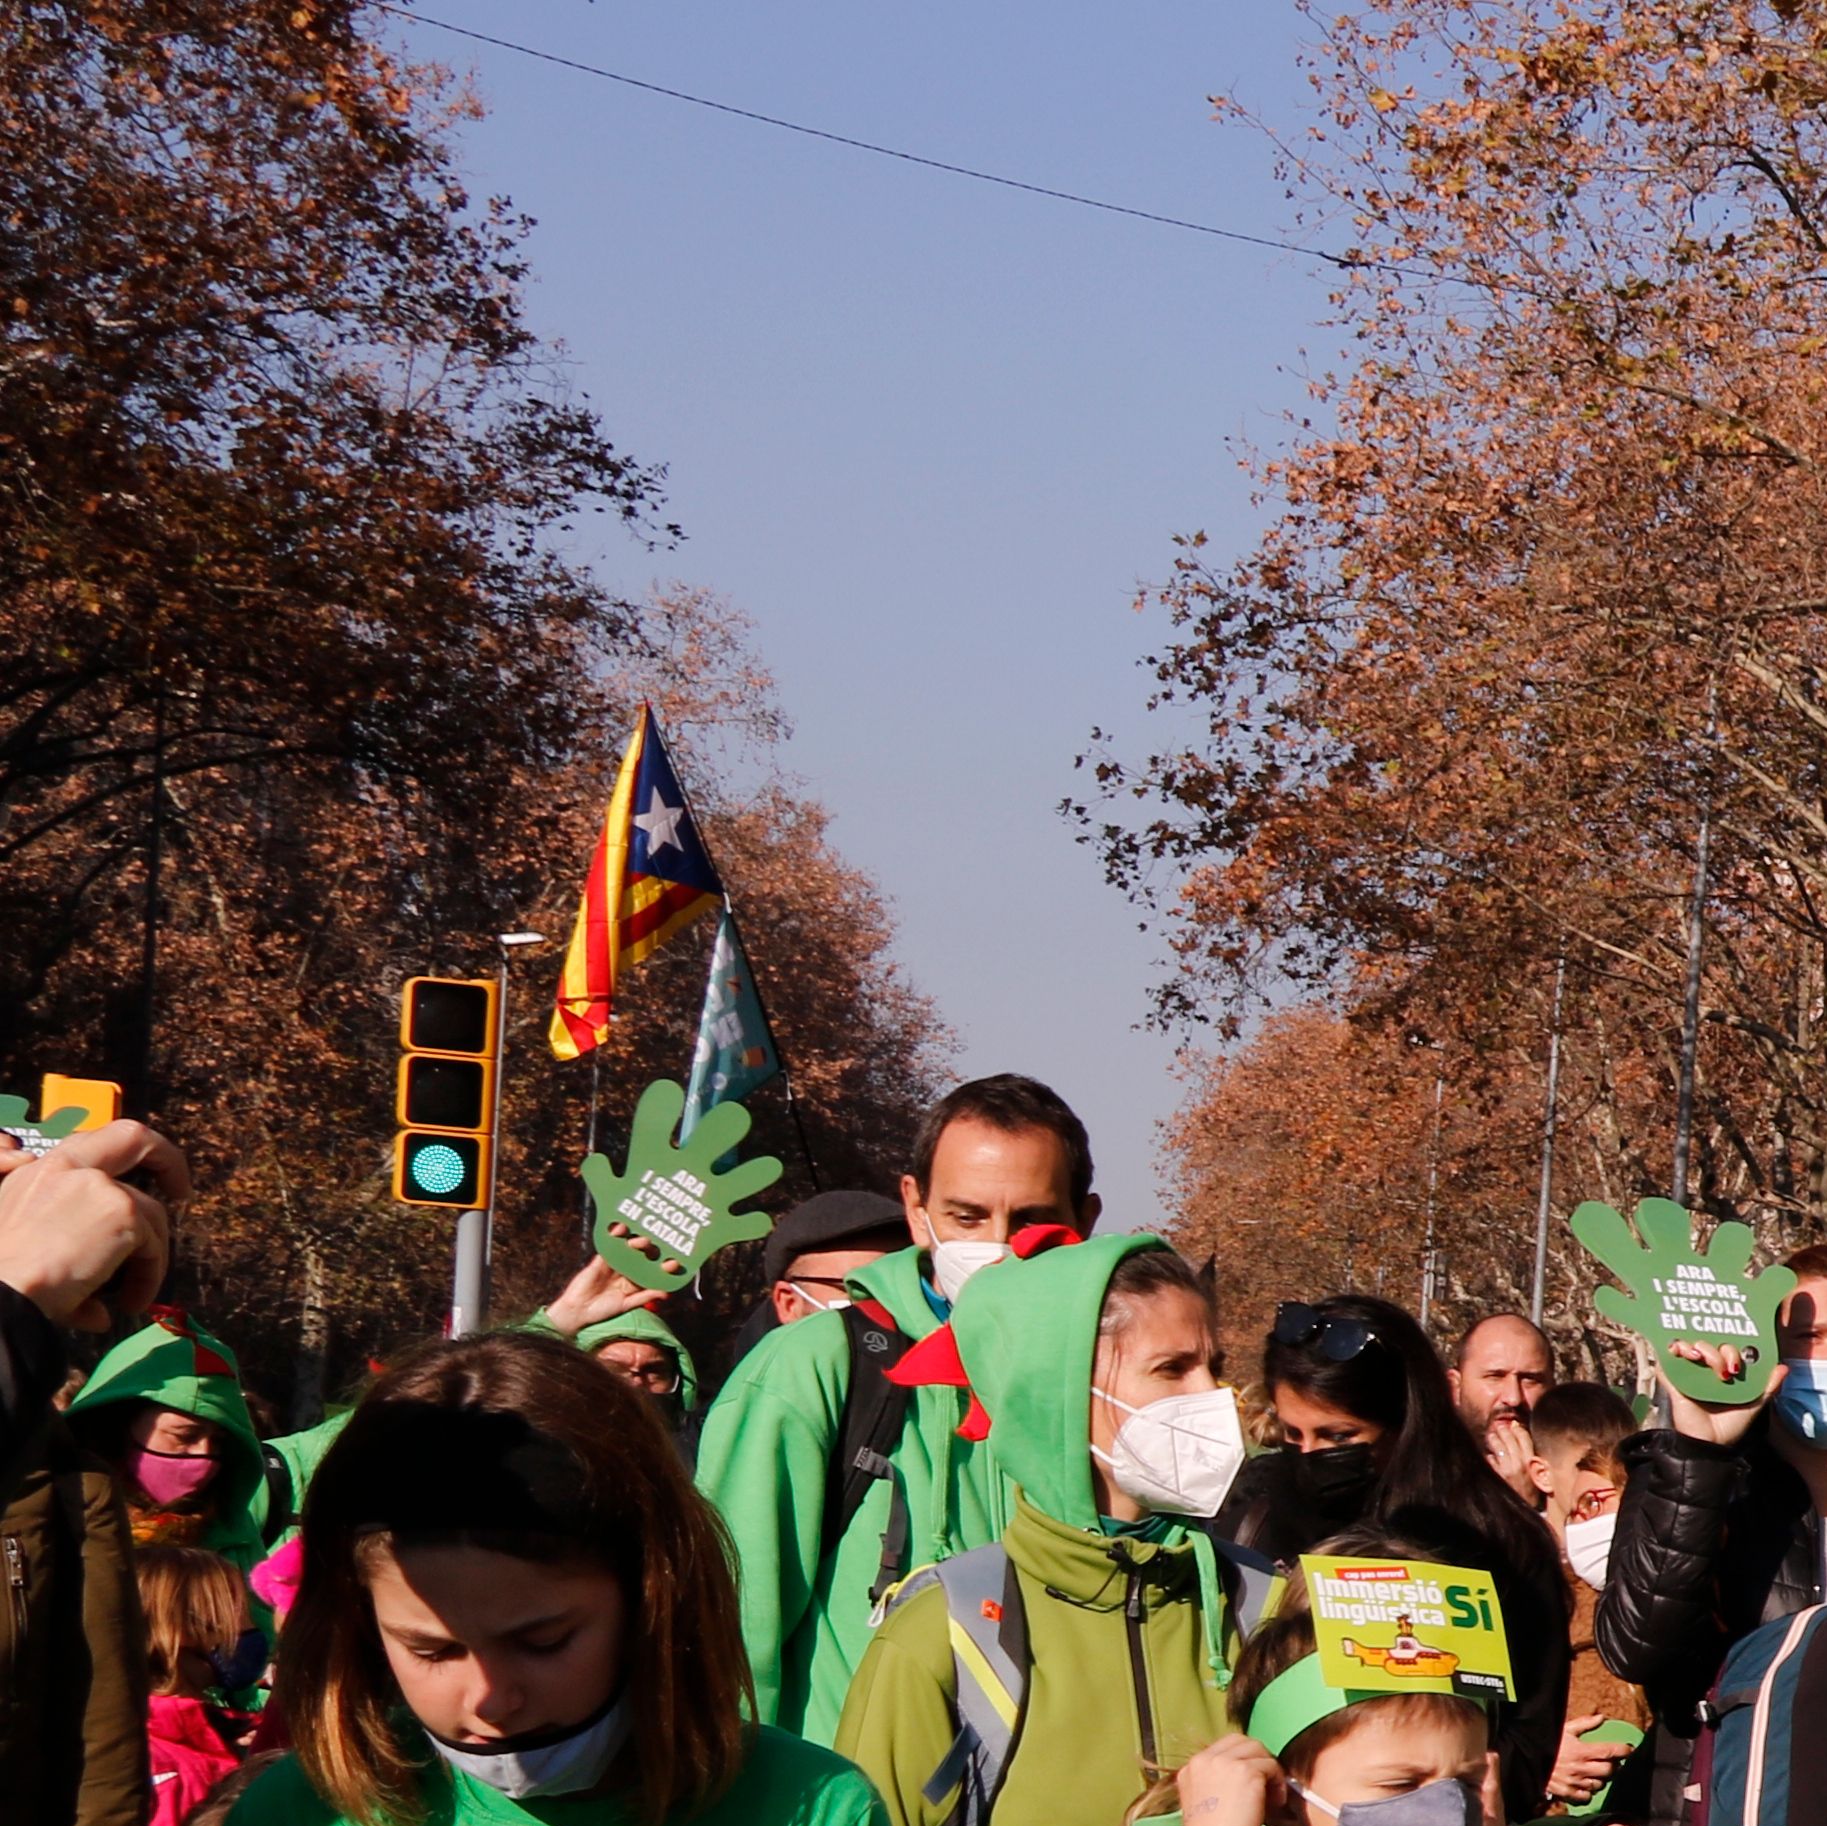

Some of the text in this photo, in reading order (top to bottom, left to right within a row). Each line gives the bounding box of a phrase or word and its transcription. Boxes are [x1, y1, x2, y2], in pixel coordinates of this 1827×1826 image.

[640, 1169, 713, 1227] I SEMPRE,
[671, 1169, 707, 1198] ARA
[617, 1199, 696, 1257] EN CATALÀ
[634, 1188, 701, 1238] L'ESCOLA
[1676, 1264, 1715, 1281] ARA
[1652, 1278, 1747, 1302] I SEMPRE,
[1663, 1296, 1749, 1318] L'ESCOLA
[1660, 1313, 1759, 1337] EN CATALÀ
[1312, 1571, 1495, 1631] Immersió Sí
[1318, 1596, 1446, 1627] lingüística
